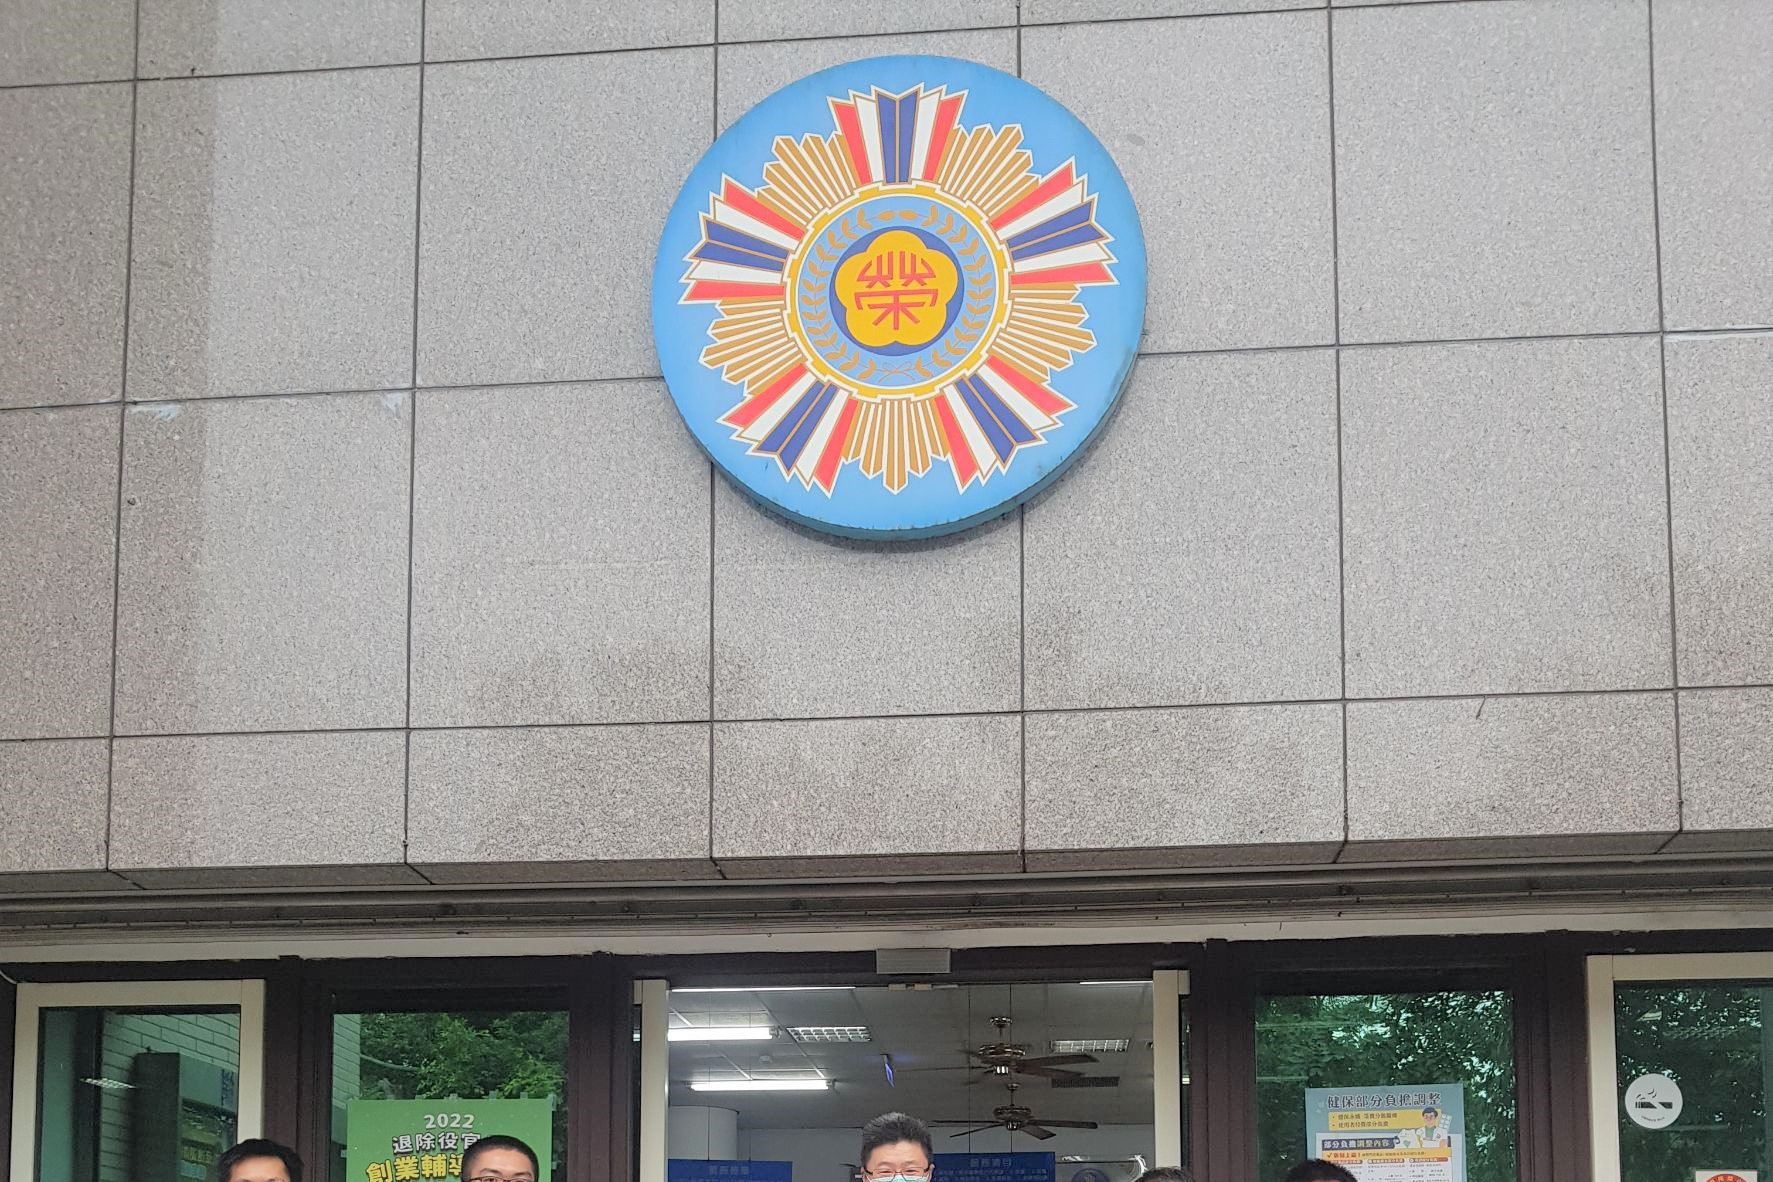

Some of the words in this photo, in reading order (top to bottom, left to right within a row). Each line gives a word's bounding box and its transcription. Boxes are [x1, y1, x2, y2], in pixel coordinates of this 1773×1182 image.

[1327, 1092, 1441, 1109] 健保部分負擔調整
[423, 1113, 475, 1129] 2022
[392, 1132, 480, 1153] 退除役官
